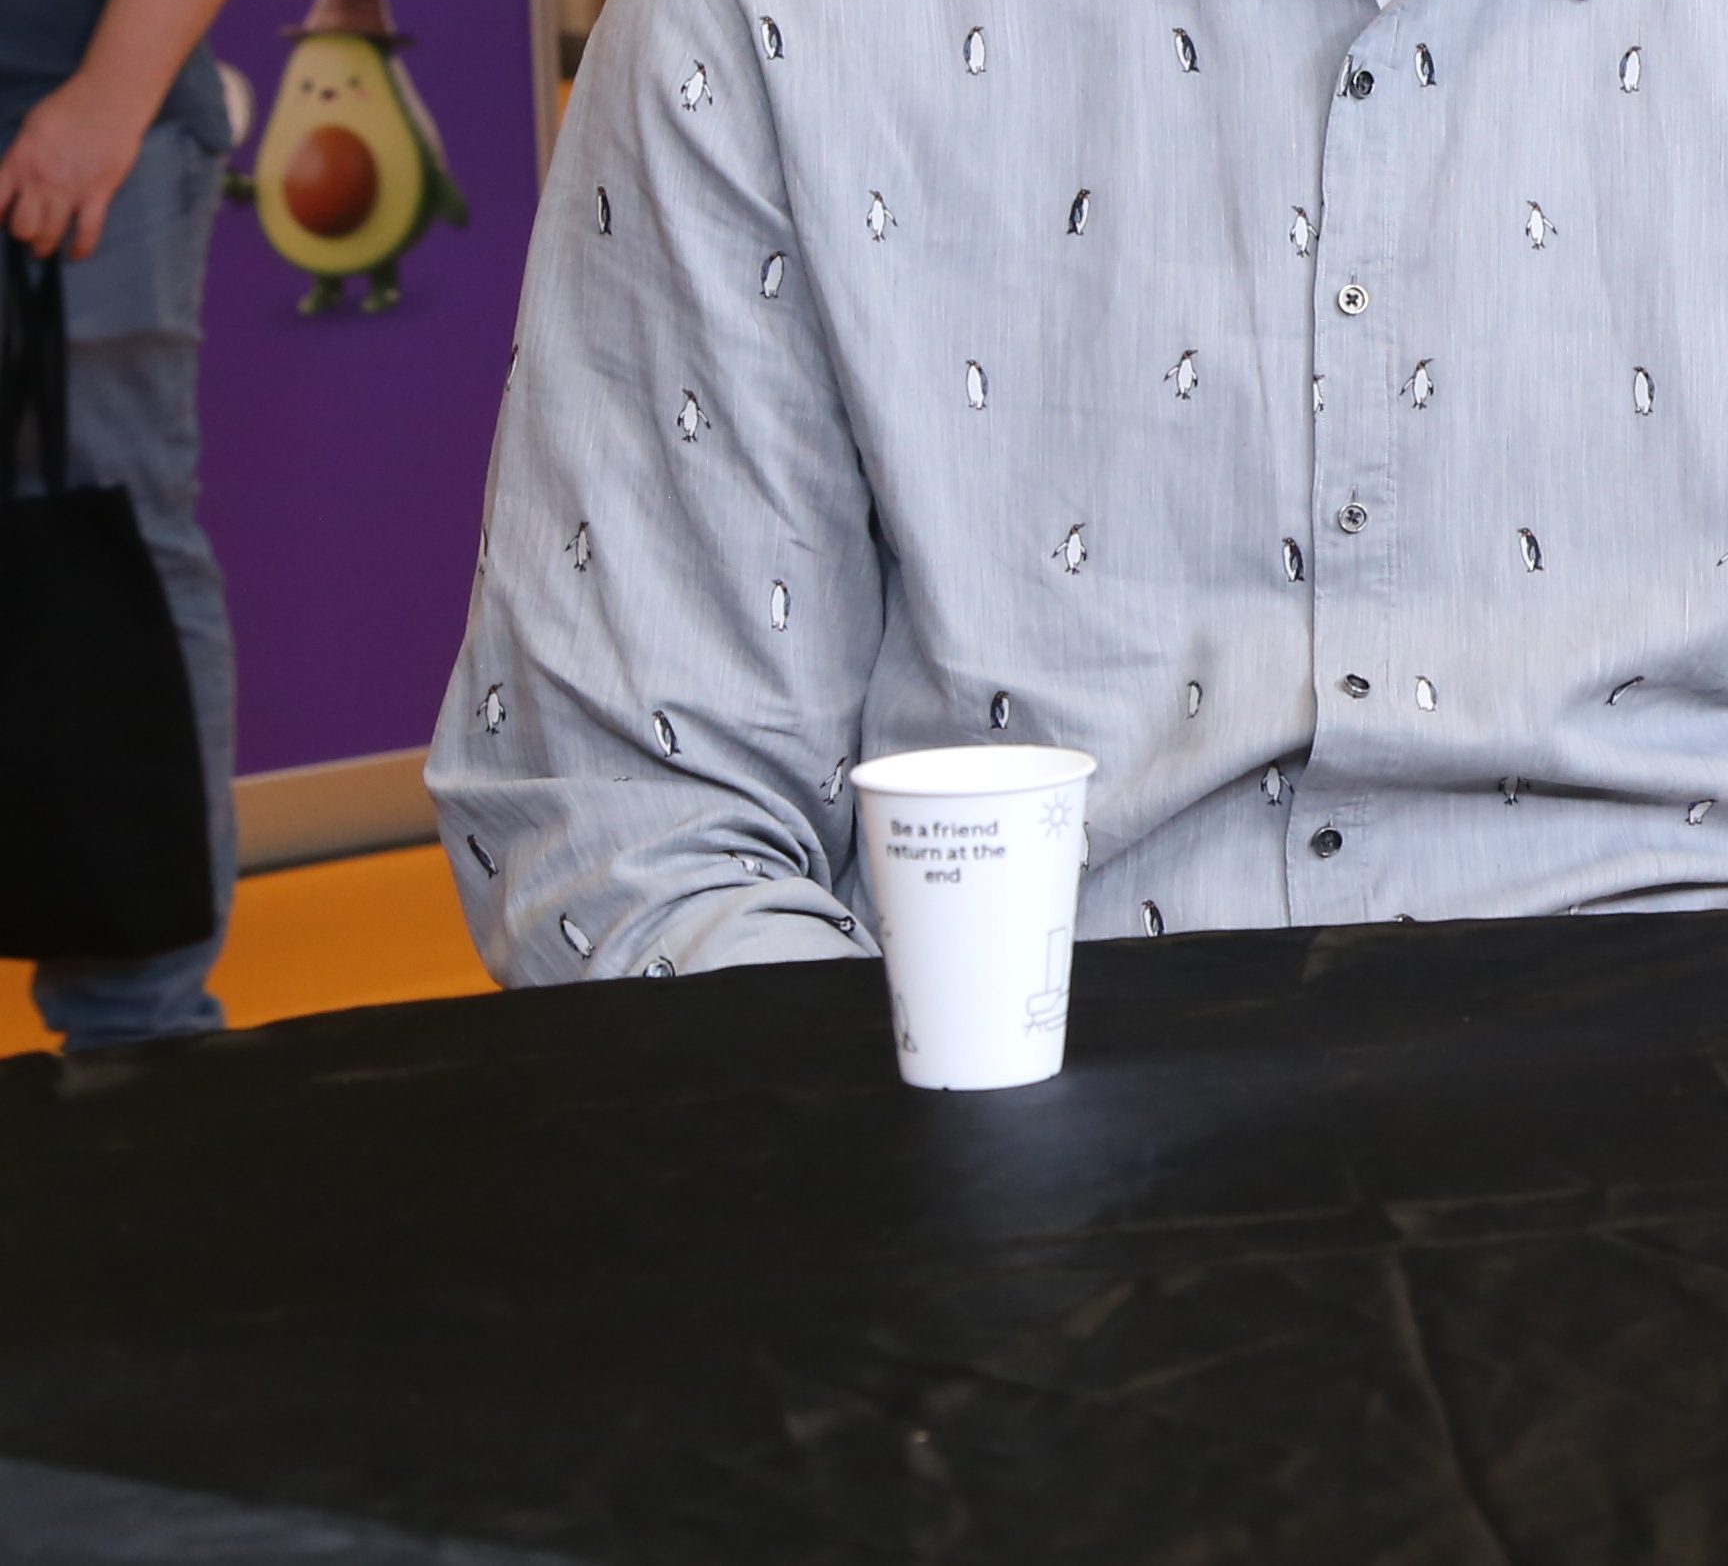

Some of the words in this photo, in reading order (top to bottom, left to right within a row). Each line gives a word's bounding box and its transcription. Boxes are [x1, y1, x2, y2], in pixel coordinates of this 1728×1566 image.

[889, 819, 914, 837] Be
[917, 825, 929, 838] a
[931, 820, 999, 837] friend
[885, 843, 942, 861] return
[946, 843, 967, 861] at
[972, 843, 1006, 860] the
[924, 868, 963, 885] end
